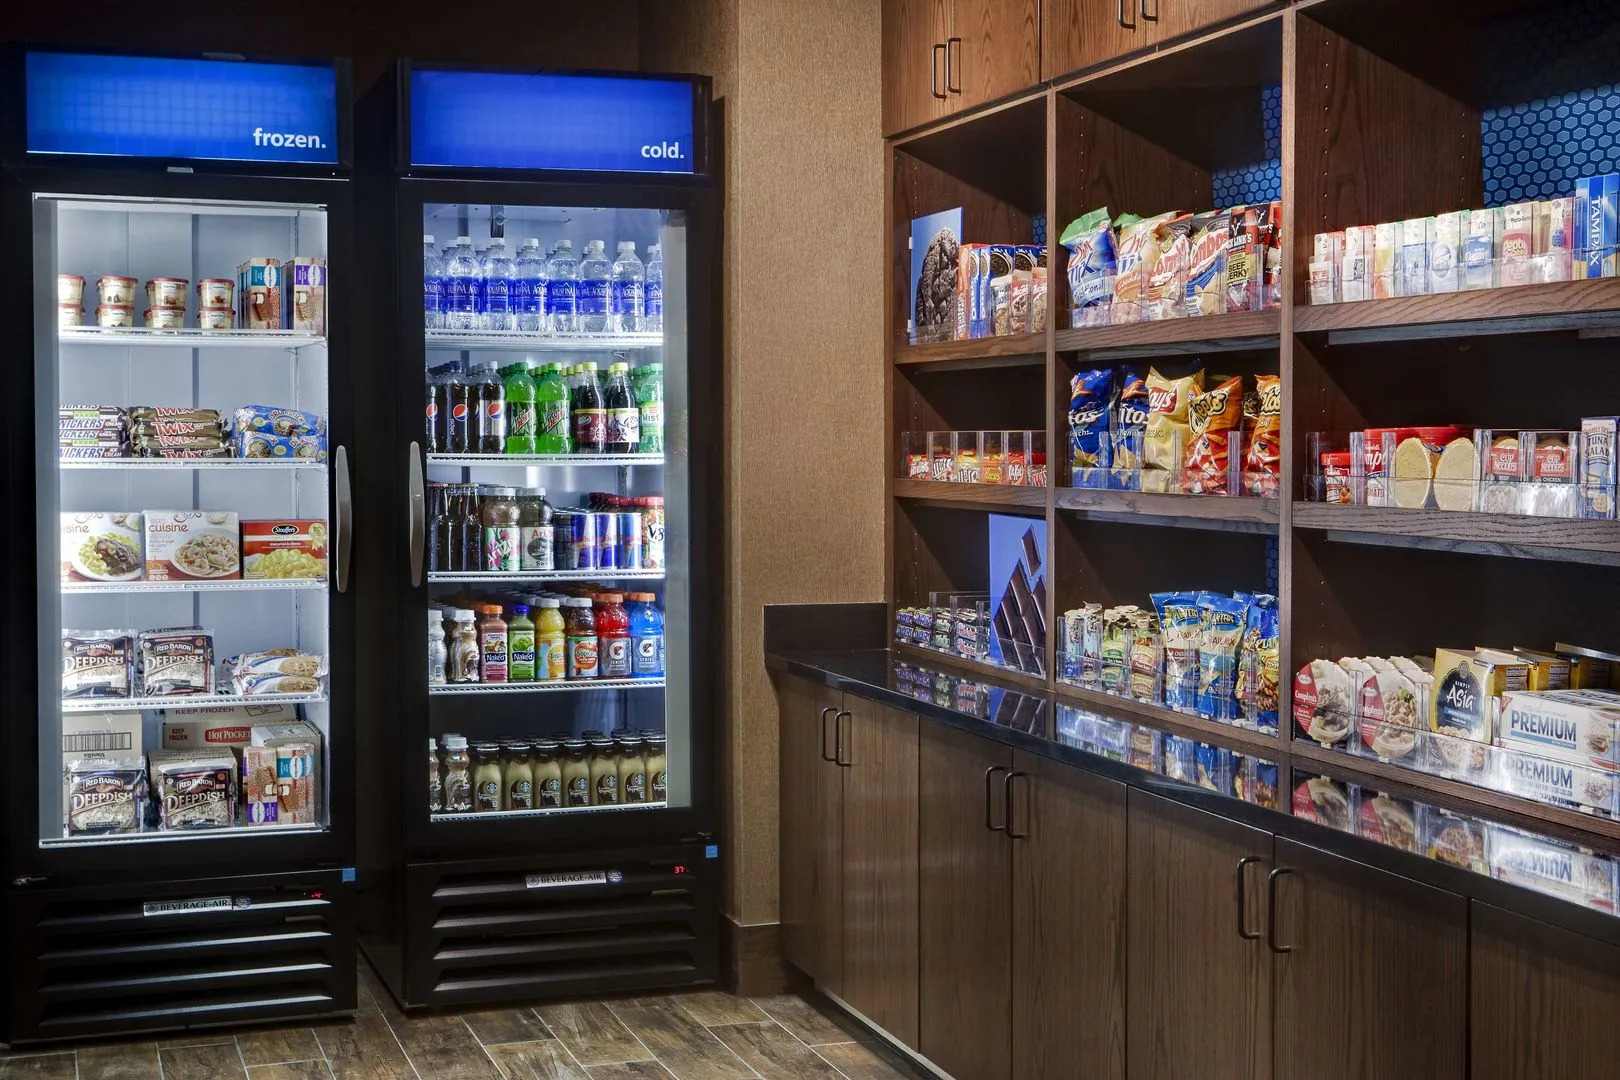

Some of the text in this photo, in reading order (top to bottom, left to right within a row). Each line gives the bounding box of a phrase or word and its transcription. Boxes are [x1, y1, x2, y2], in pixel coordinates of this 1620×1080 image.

[253, 127, 326, 148] frozen.
[641, 142, 684, 158] cold.
[1590, 195, 1601, 266] TAMPAX
[1228, 261, 1246, 272] BEEF
[1588, 436, 1608, 447] TUNA
[148, 523, 188, 533] cuisine
[170, 643, 192, 651] BARON
[1446, 684, 1474, 712] Asia
[1511, 709, 1576, 742] PREMIUM
[1505, 755, 1572, 789] PREMIUM
[86, 777, 121, 788] RED BARON
[178, 780, 192, 788] RED
[540, 874, 602, 884] BEVERAGE-AIR
[160, 899, 228, 911] BEVERAGE-AIR
